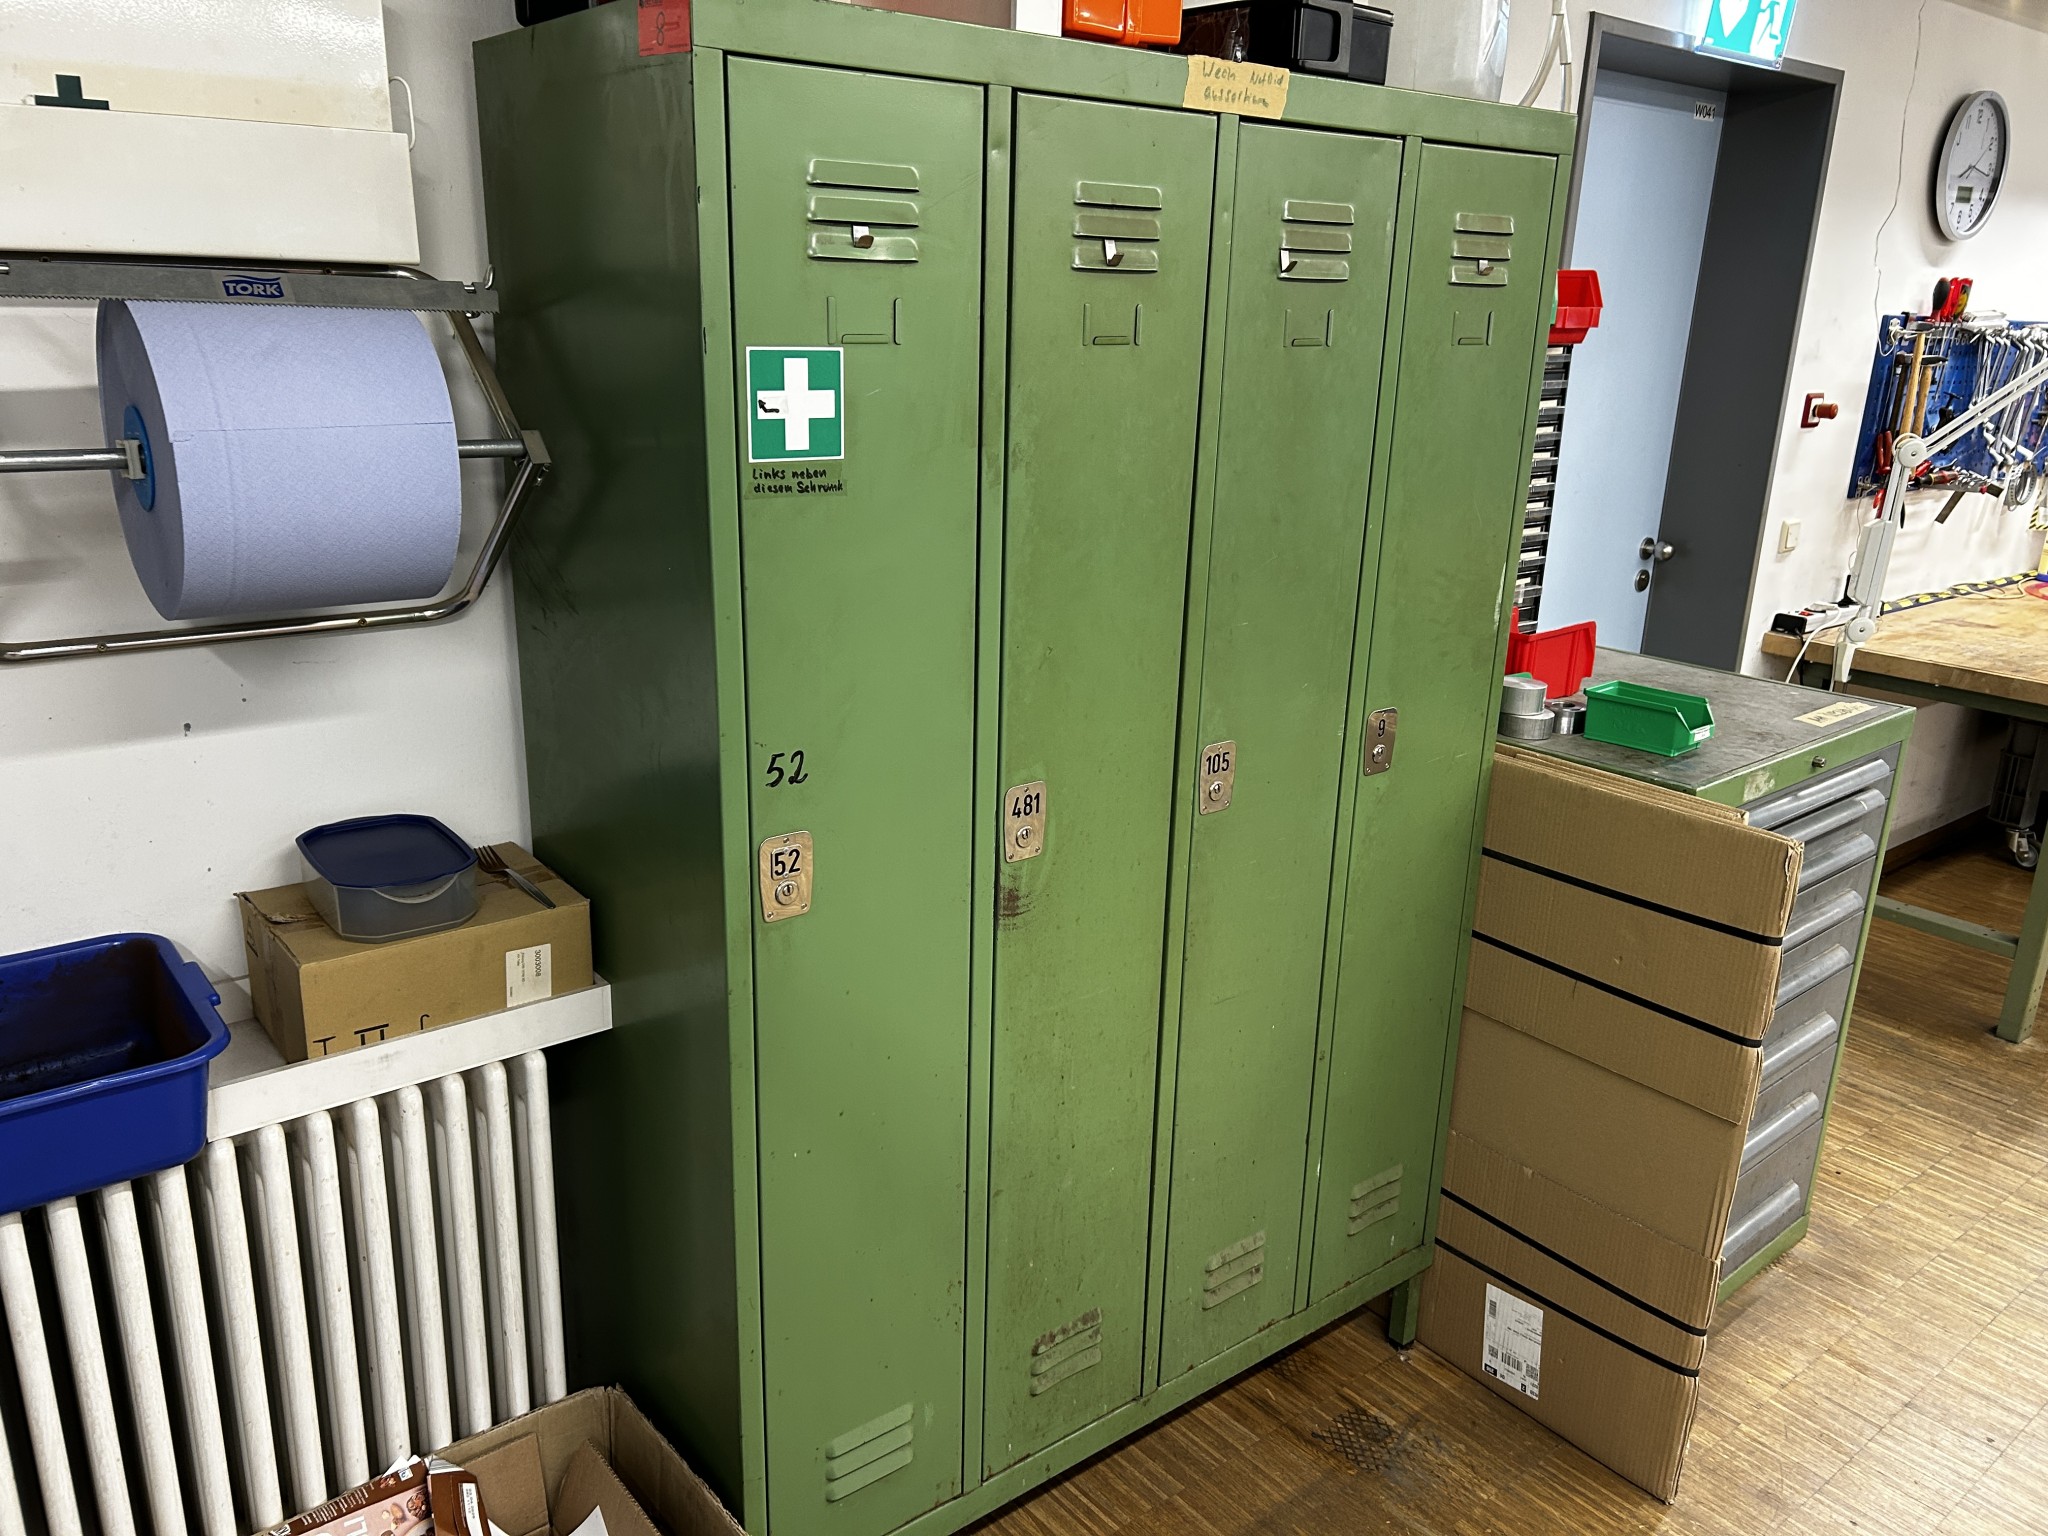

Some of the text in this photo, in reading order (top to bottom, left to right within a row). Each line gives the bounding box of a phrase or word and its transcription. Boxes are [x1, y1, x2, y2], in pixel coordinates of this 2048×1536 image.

[1696, 104, 1716, 119] W041
[225, 282, 281, 296] TORK
[752, 467, 827, 480] Links neben
[753, 483, 793, 494] diesem
[1378, 719, 1385, 737] 9
[765, 750, 809, 788] 52
[1206, 751, 1230, 775] 105
[1012, 792, 1040, 818] 481
[774, 848, 801, 877] 52
